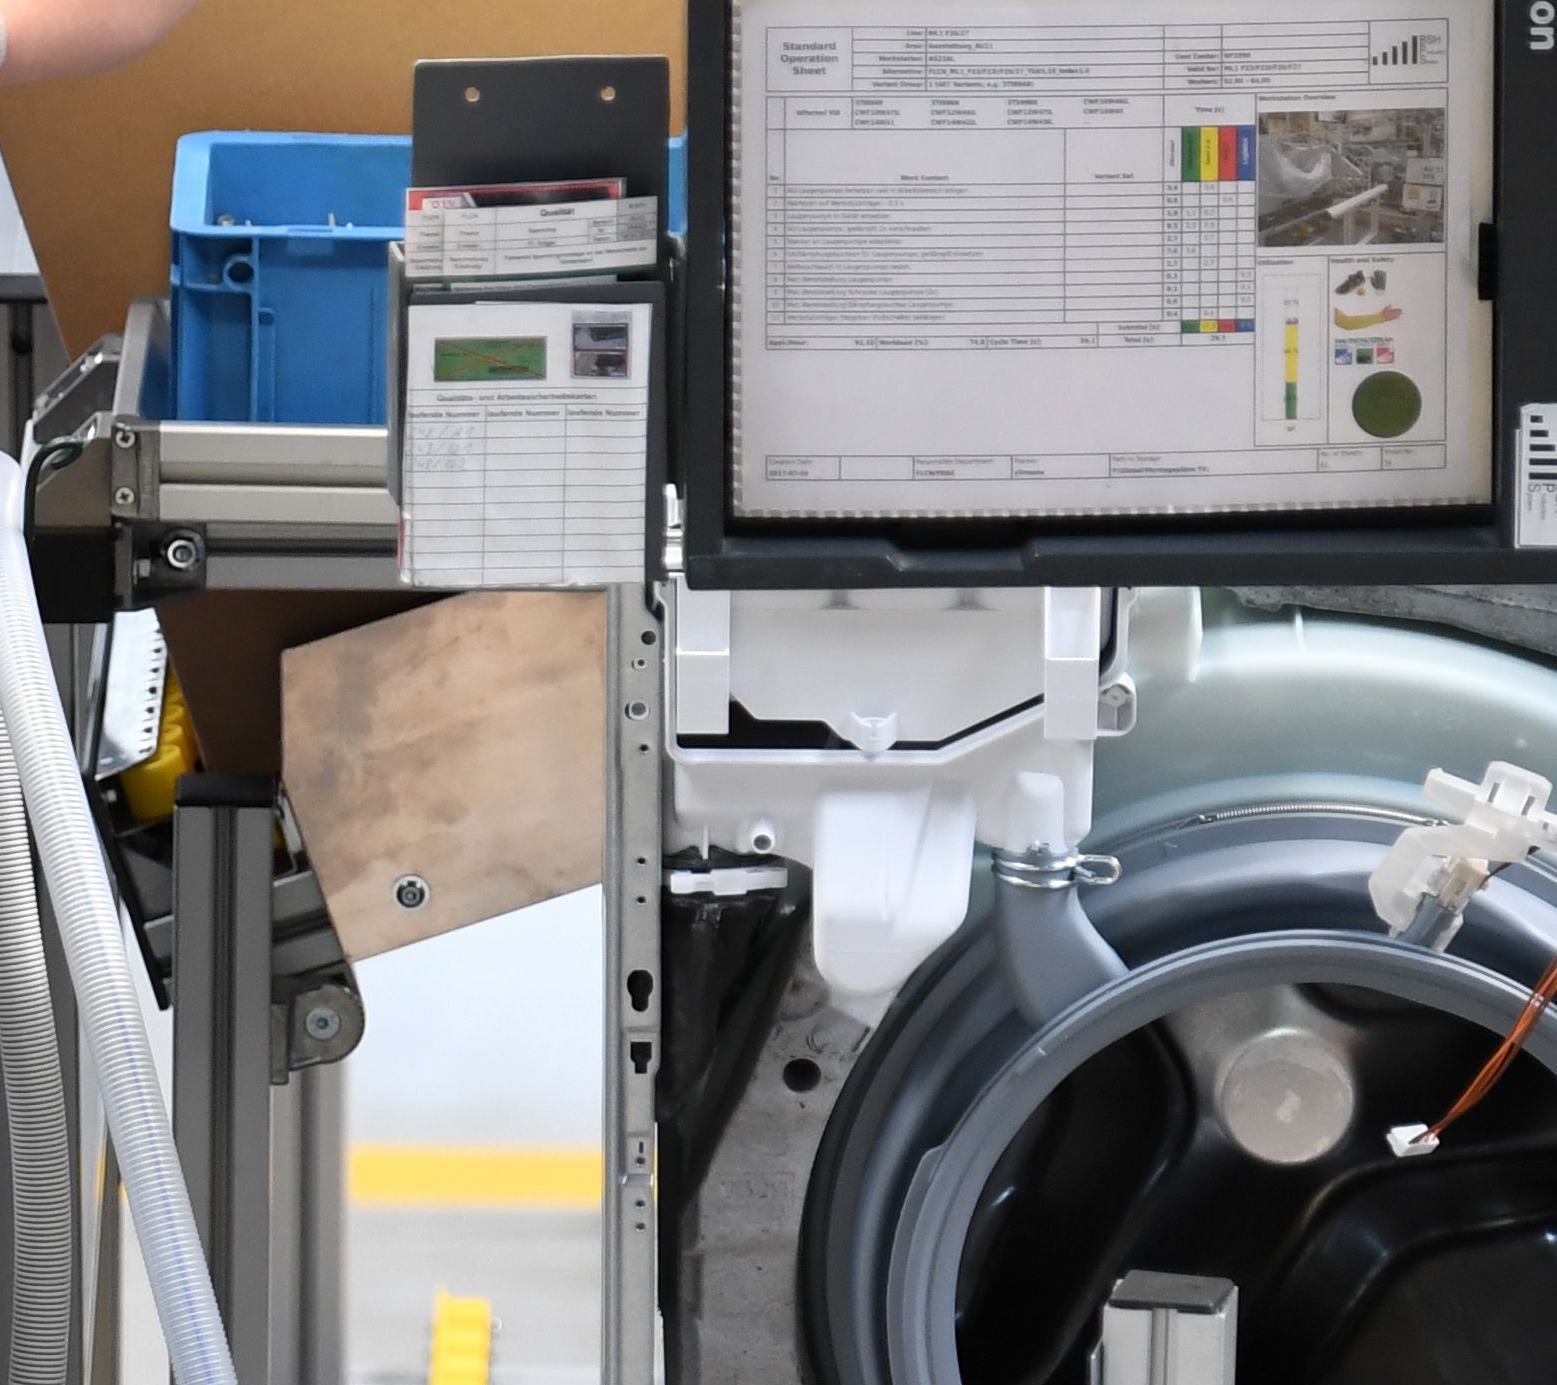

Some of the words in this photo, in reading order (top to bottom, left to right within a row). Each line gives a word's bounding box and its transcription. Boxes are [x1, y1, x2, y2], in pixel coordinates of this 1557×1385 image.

[783, 42, 836, 50] Standard
[780, 54, 839, 64] Operation
[792, 66, 827, 75] Sheet
